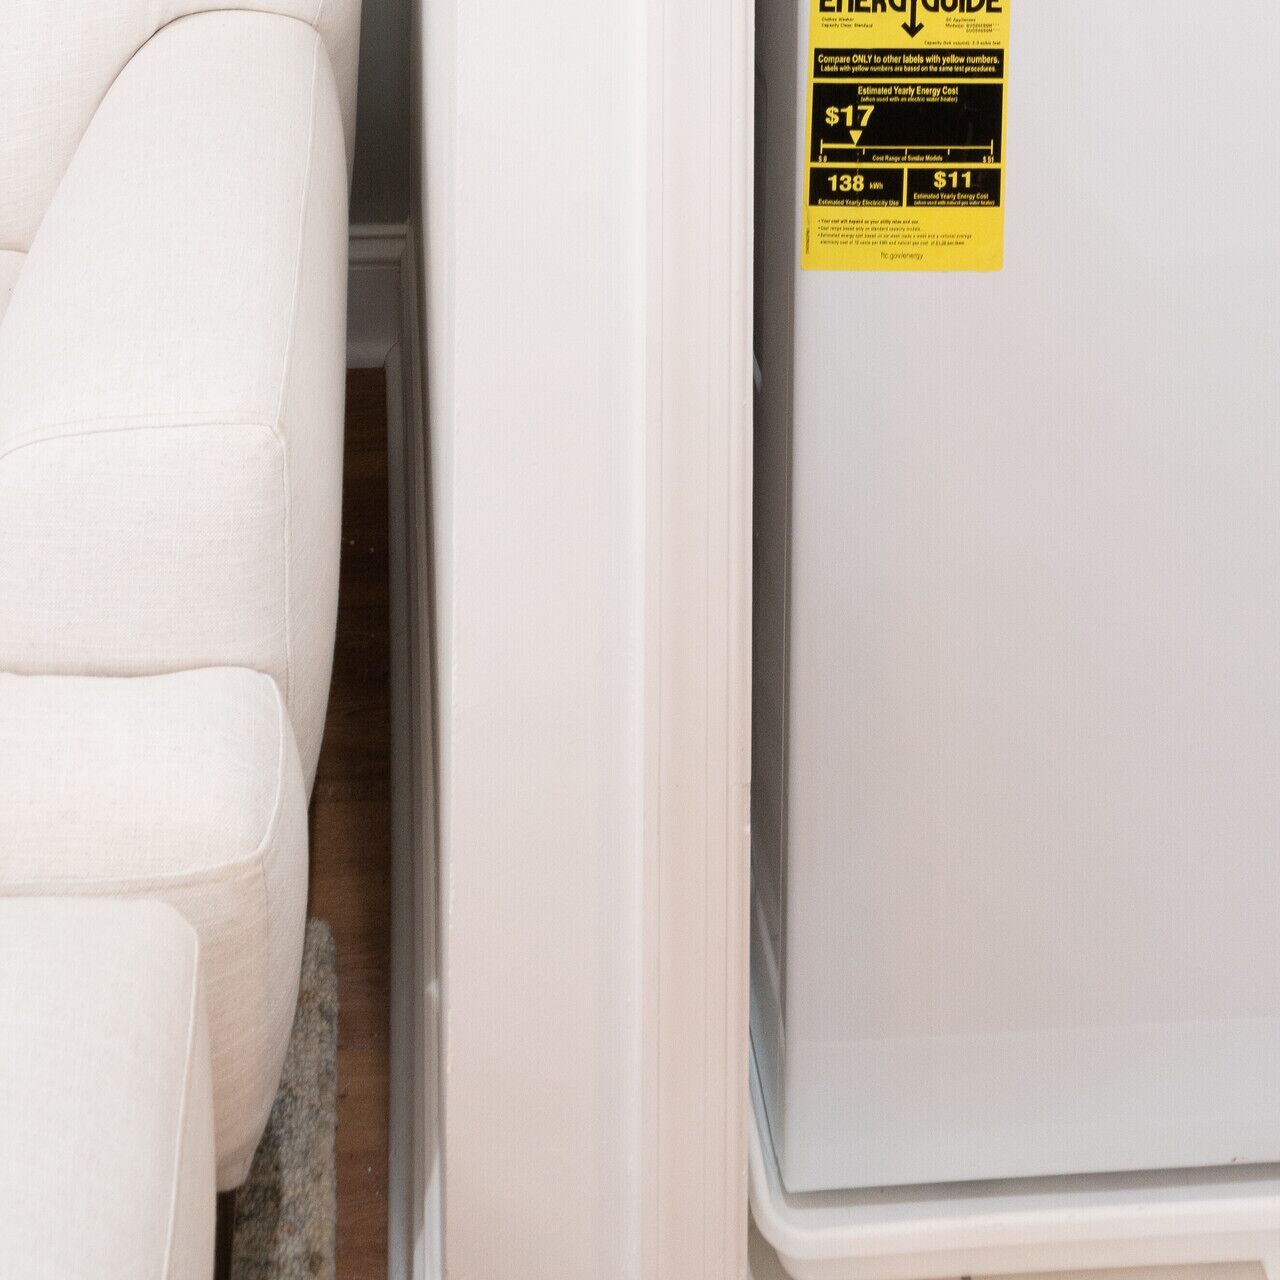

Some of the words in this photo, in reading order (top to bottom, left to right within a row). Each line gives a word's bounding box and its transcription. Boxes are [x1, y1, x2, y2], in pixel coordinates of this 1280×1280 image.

[818, 53, 851, 65] Compare
[851, 53, 873, 64] ONLY
[873, 53, 882, 64] to
[882, 53, 902, 64] other
[902, 53, 924, 64] labels
[925, 53, 941, 64] with
[942, 53, 966, 66] yellow
[851, 65, 870, 73] yellow
[857, 85, 893, 95] Estimated
[892, 85, 916, 97] Yearly
[916, 85, 941, 96] Energy
[942, 86, 959, 95] Cost
[825, 105, 875, 127] $17
[827, 174, 865, 192] 138
[869, 182, 884, 190] kWh
[933, 170, 972, 190] $11
[818, 198, 845, 206] Estimated
[845, 199, 861, 207] Yearly
[862, 199, 888, 207] Electricity
[913, 192, 940, 200] Estimated
[940, 192, 957, 201] Yearly
[957, 193, 975, 201] Energy
